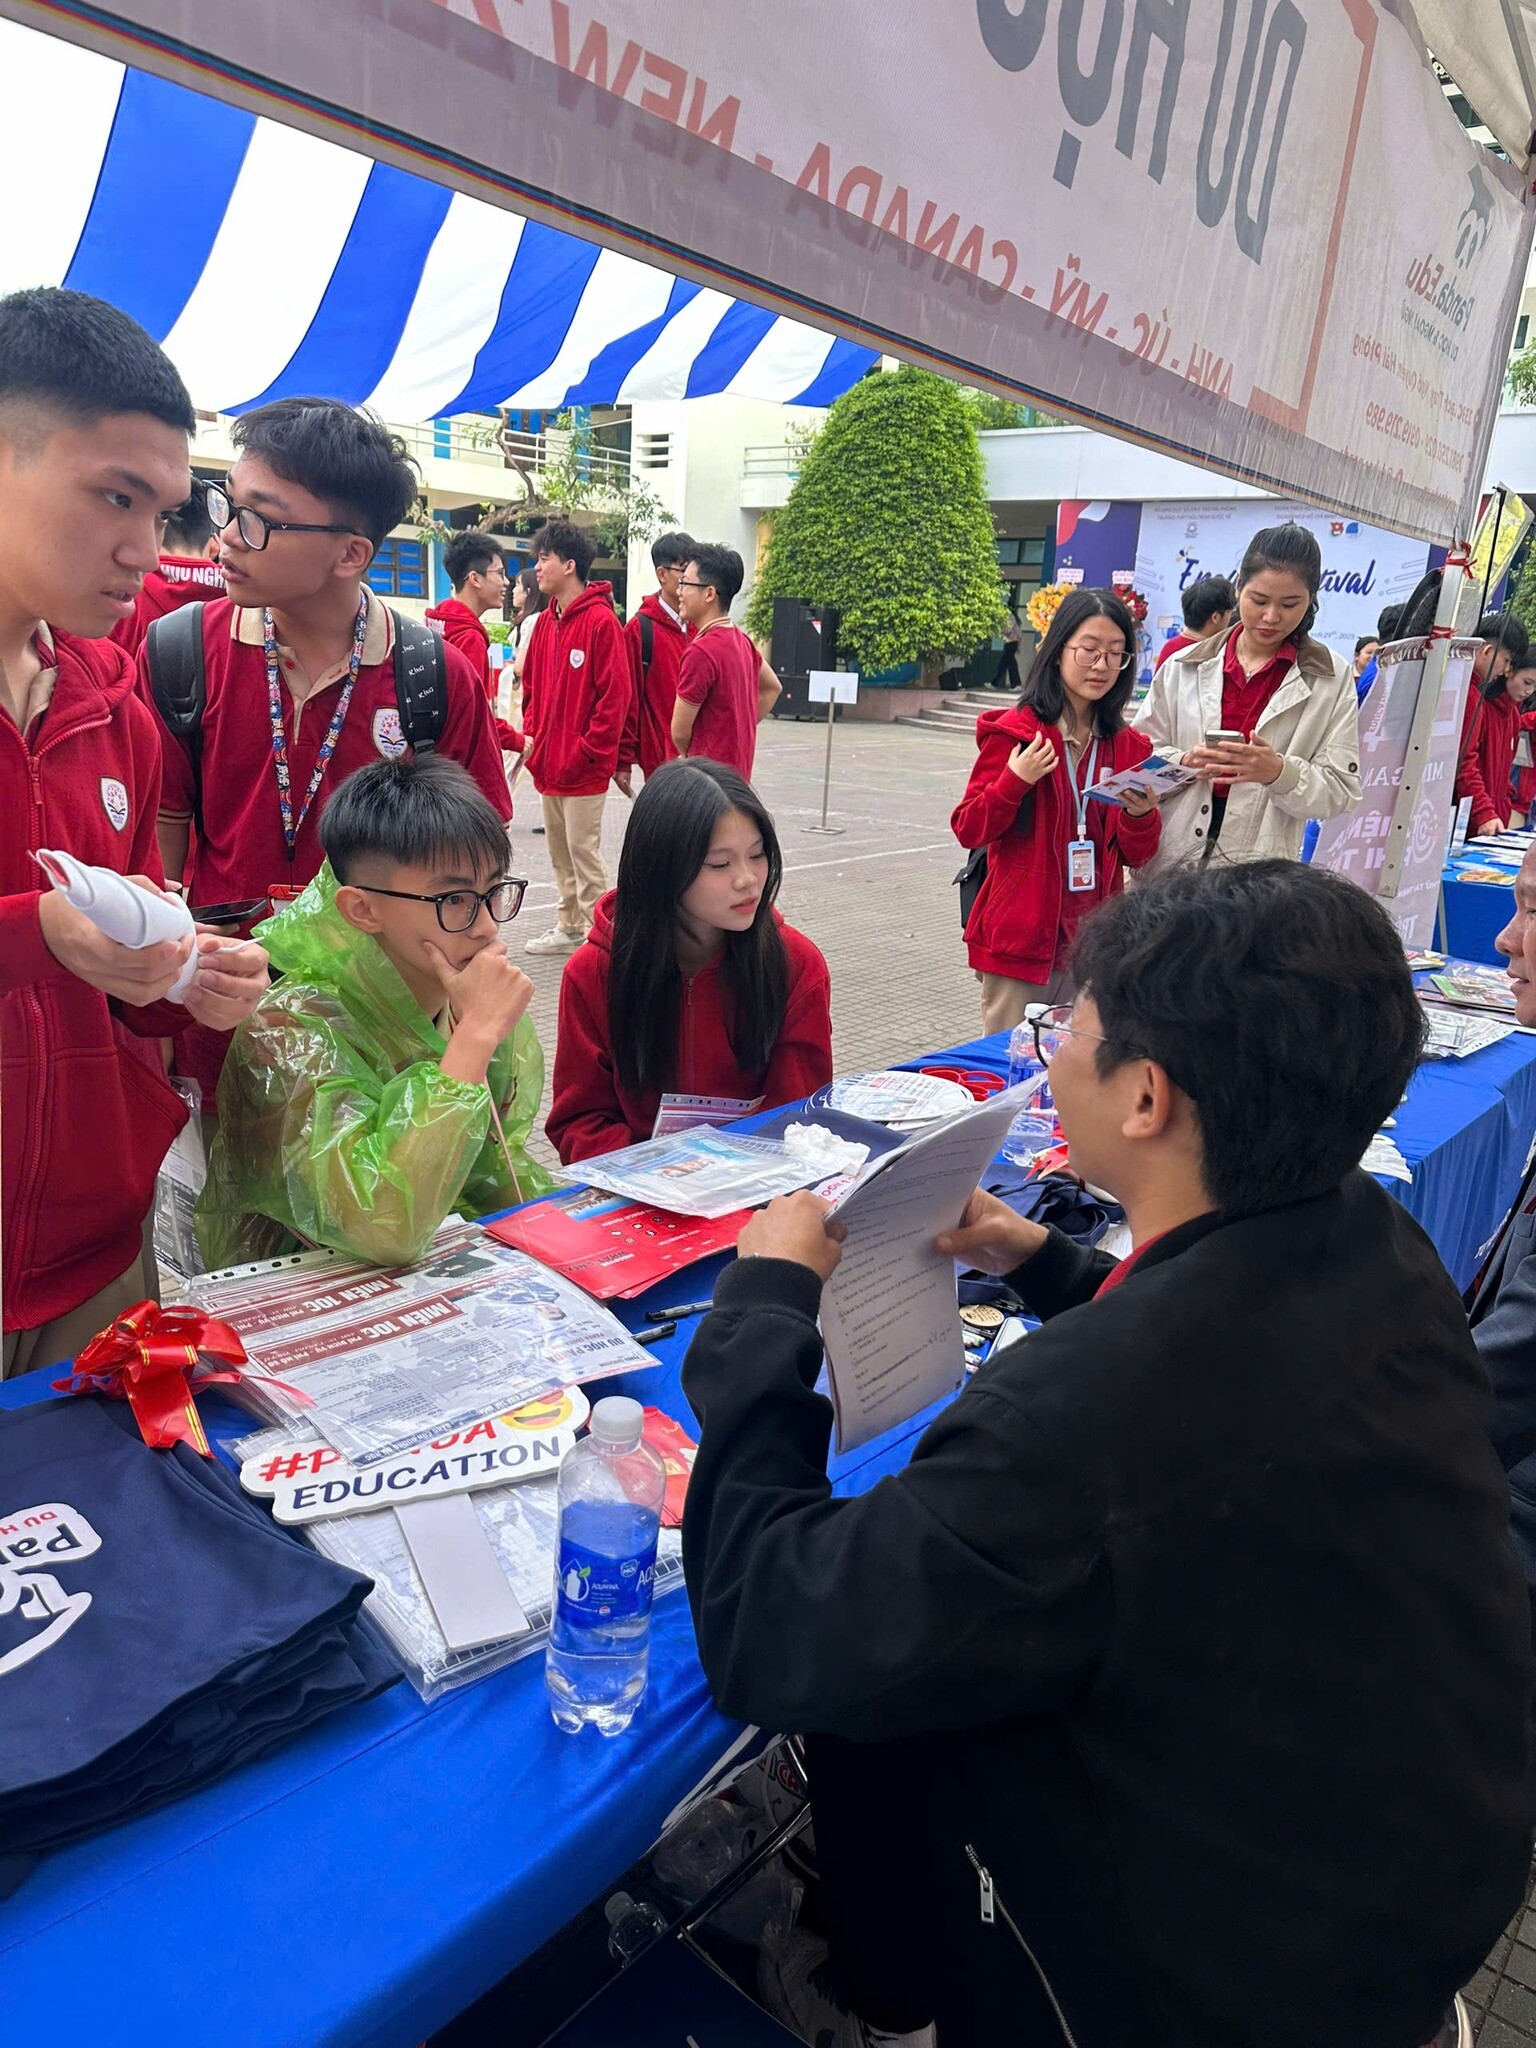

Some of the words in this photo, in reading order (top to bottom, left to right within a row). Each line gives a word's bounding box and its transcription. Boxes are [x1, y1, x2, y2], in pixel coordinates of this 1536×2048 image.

[1318, 559, 1376, 596] tival
[398, 1302, 451, 1327] MIỄN
[607, 1337, 625, 1347] DU
[259, 1419, 498, 1483] #PA
[292, 1435, 561, 1511] EDUCATION
[0, 1524, 19, 1535] H
[24, 1511, 59, 1528] DU
